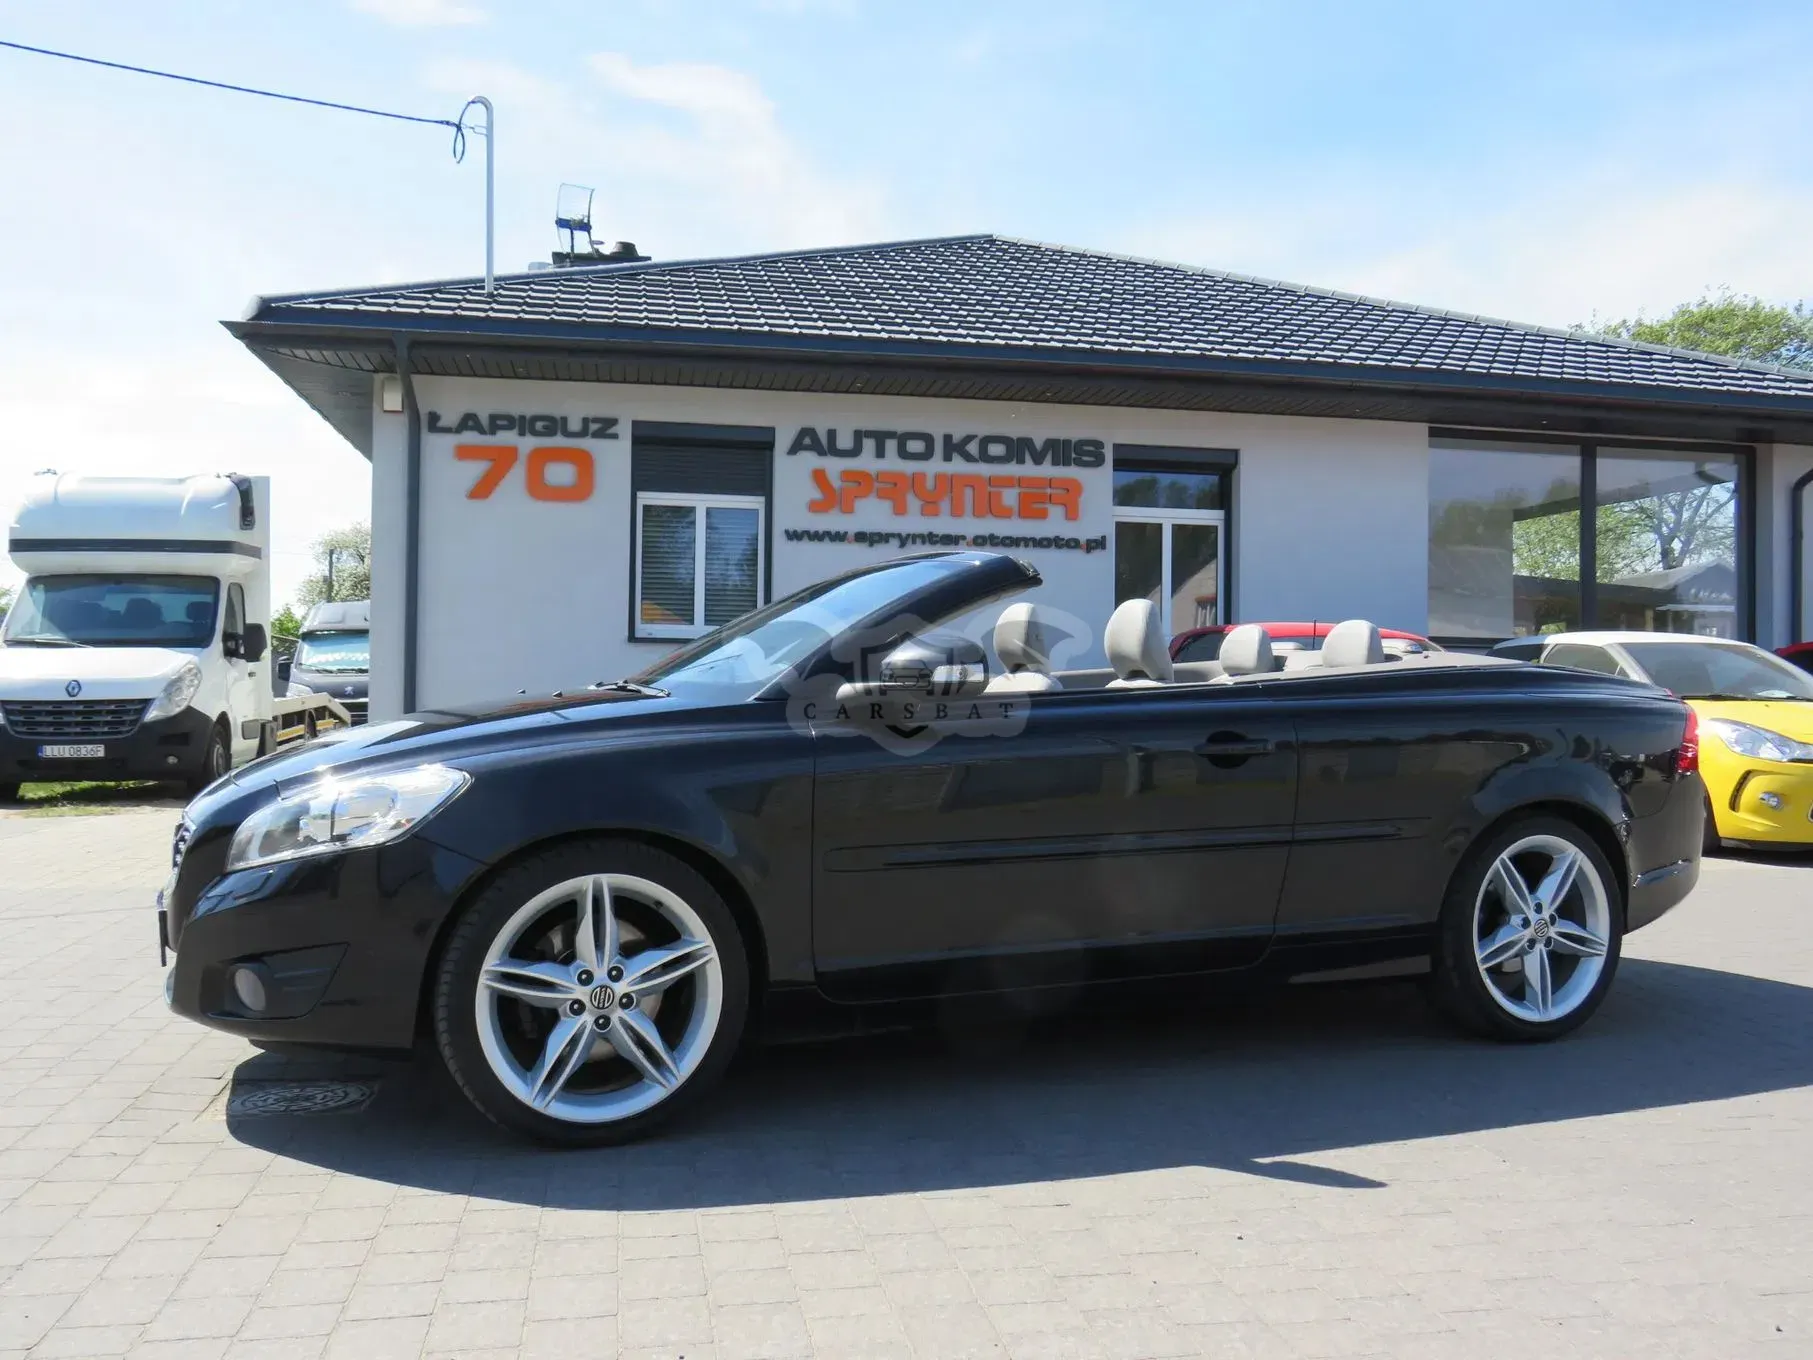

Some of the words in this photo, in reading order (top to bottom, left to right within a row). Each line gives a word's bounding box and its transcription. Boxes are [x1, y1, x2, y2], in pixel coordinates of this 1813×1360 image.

[427, 411, 619, 440] ŁAPIGUZ
[786, 427, 935, 461] AUTO
[942, 433, 1106, 468] KOMIS
[454, 444, 595, 503] 70
[808, 468, 1084, 521] SPRYNTER
[784, 528, 1107, 553] www.sprynter.otomoto.pl
[44, 745, 66, 757] LLU
